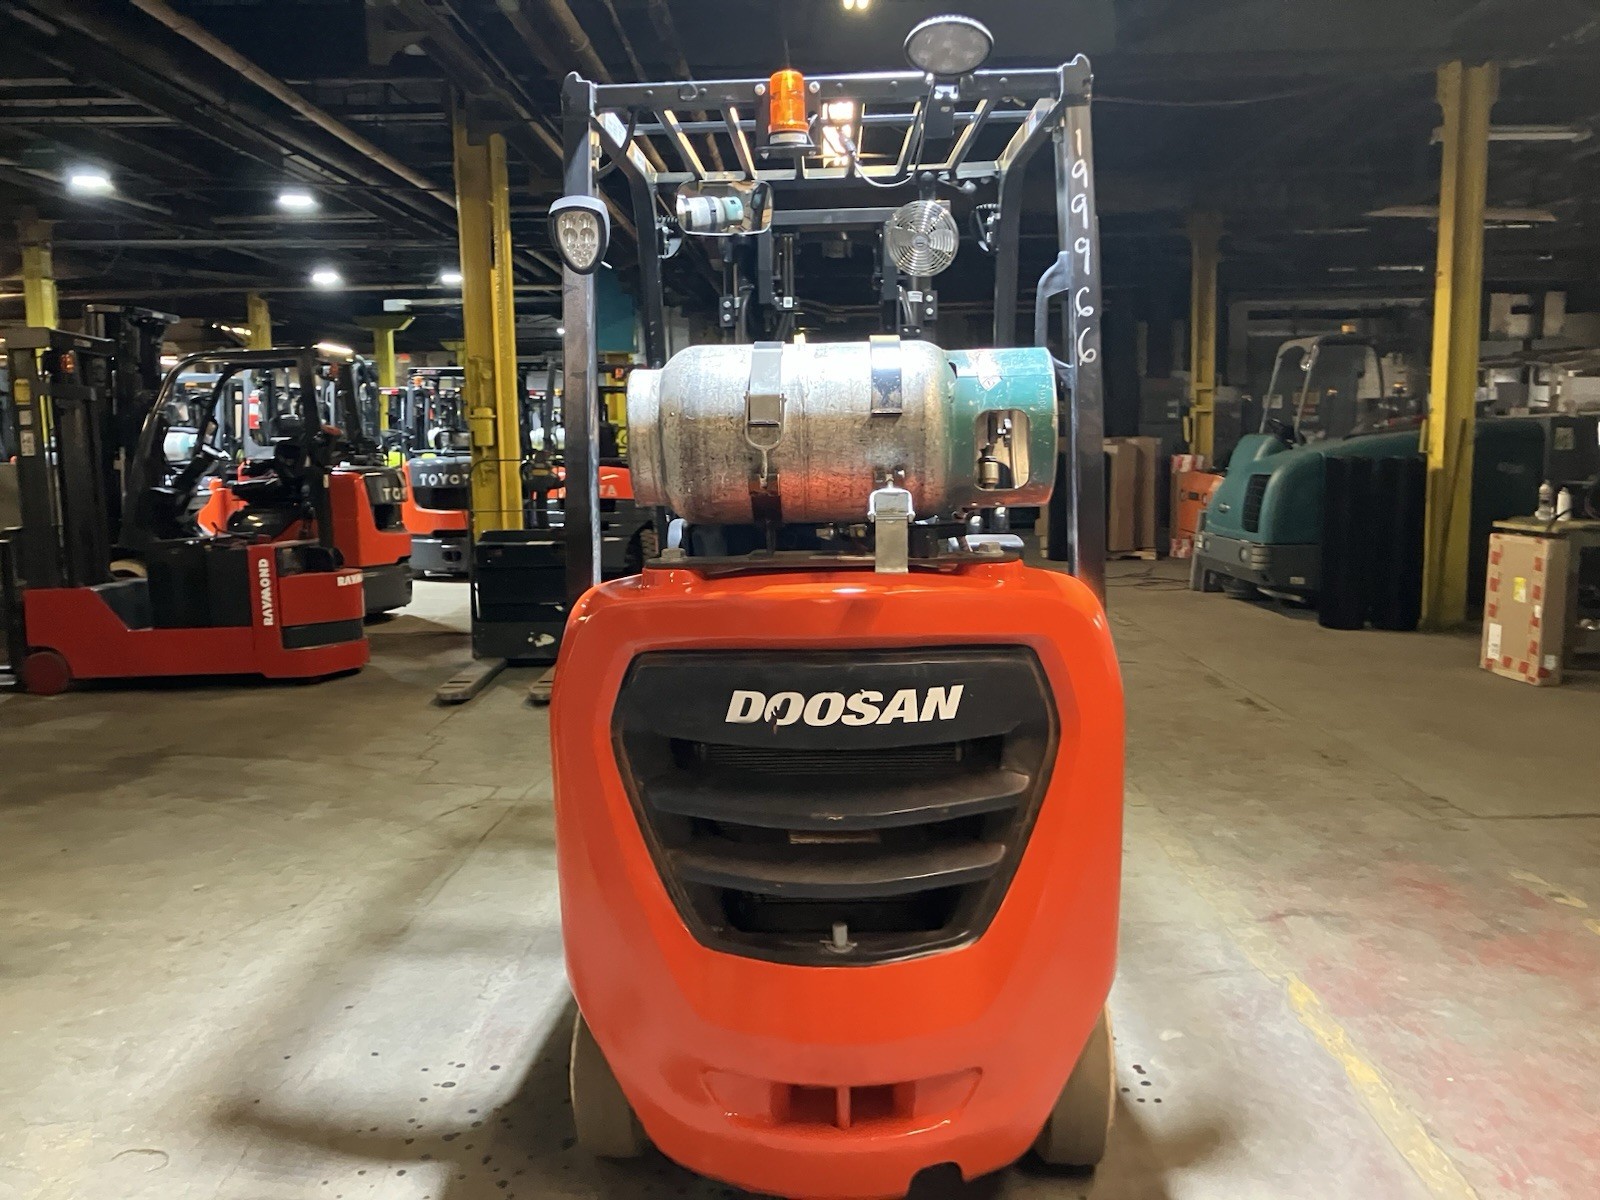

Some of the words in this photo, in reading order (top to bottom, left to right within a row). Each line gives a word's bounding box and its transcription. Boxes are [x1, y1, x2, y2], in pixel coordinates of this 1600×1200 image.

[1071, 128, 1097, 366] 199966
[258, 558, 274, 626] RAYMOND
[725, 684, 964, 726] DOOSAN
